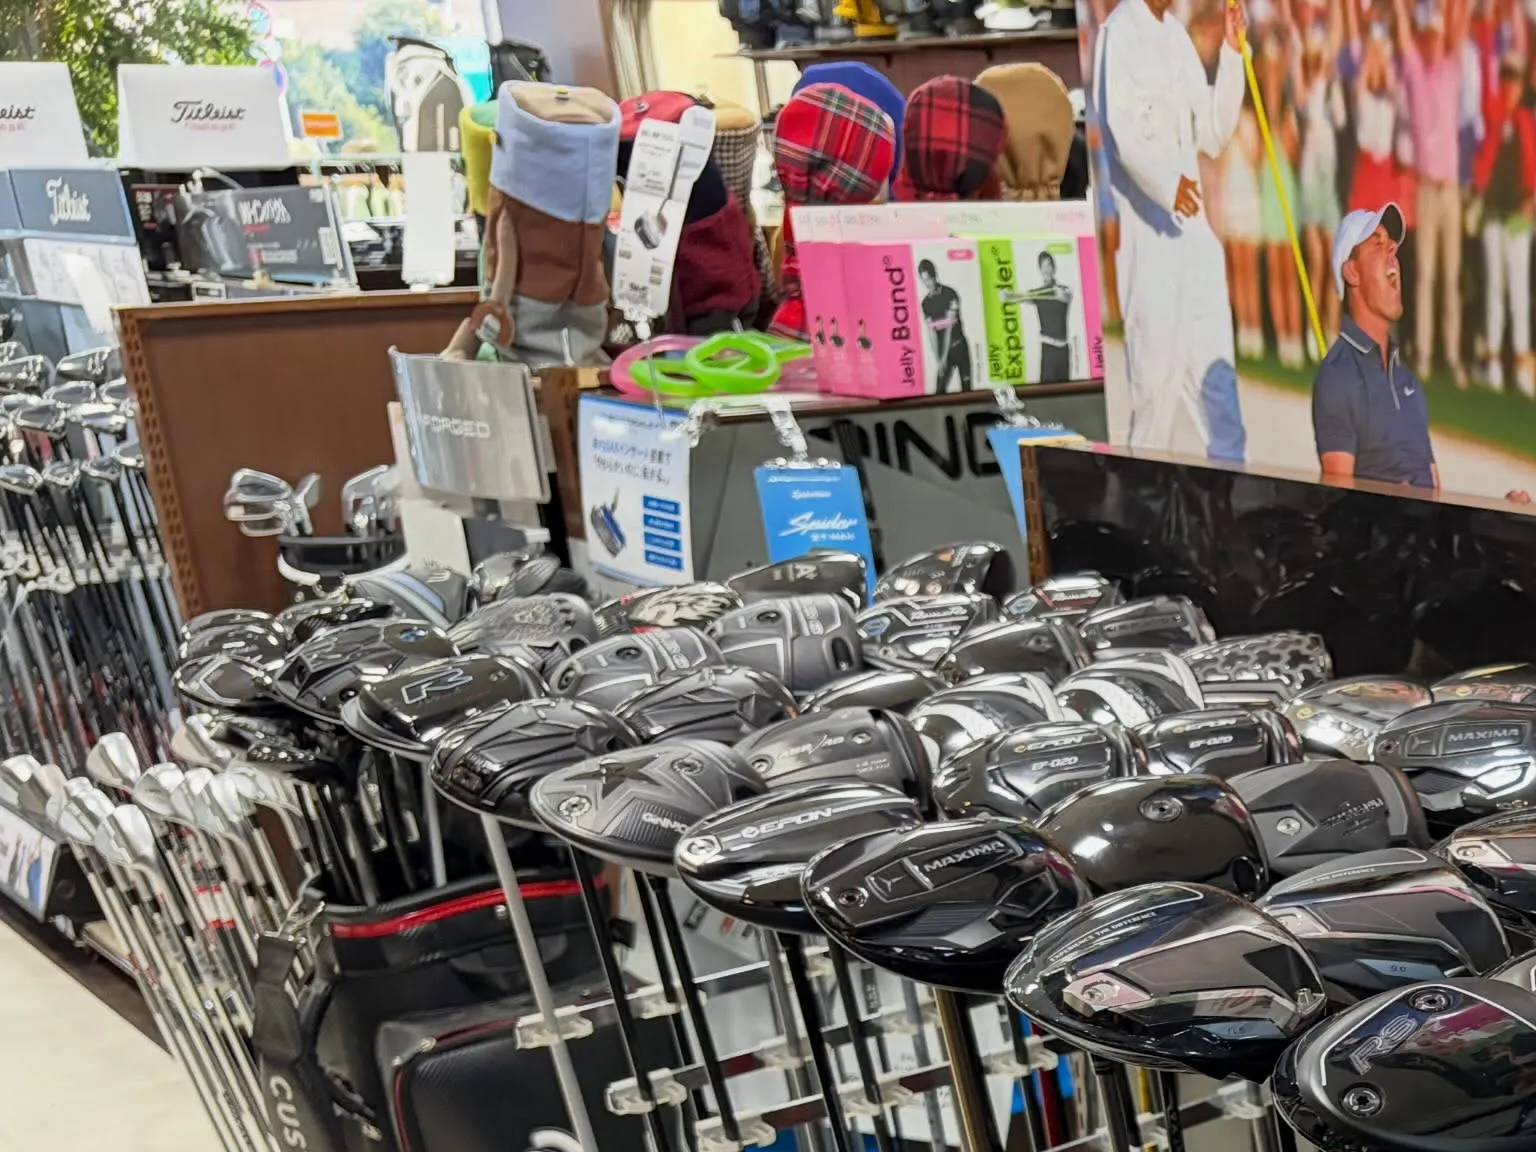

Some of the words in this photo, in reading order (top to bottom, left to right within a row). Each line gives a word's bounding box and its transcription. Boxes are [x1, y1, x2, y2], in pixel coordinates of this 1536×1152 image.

[171, 100, 248, 123] Titleist
[900, 346, 916, 387] Jelly
[778, 511, 858, 537] Spider
[1447, 727, 1521, 743] MAXIMA
[758, 807, 833, 833] EPON
[923, 838, 1007, 873] MAXIMA
